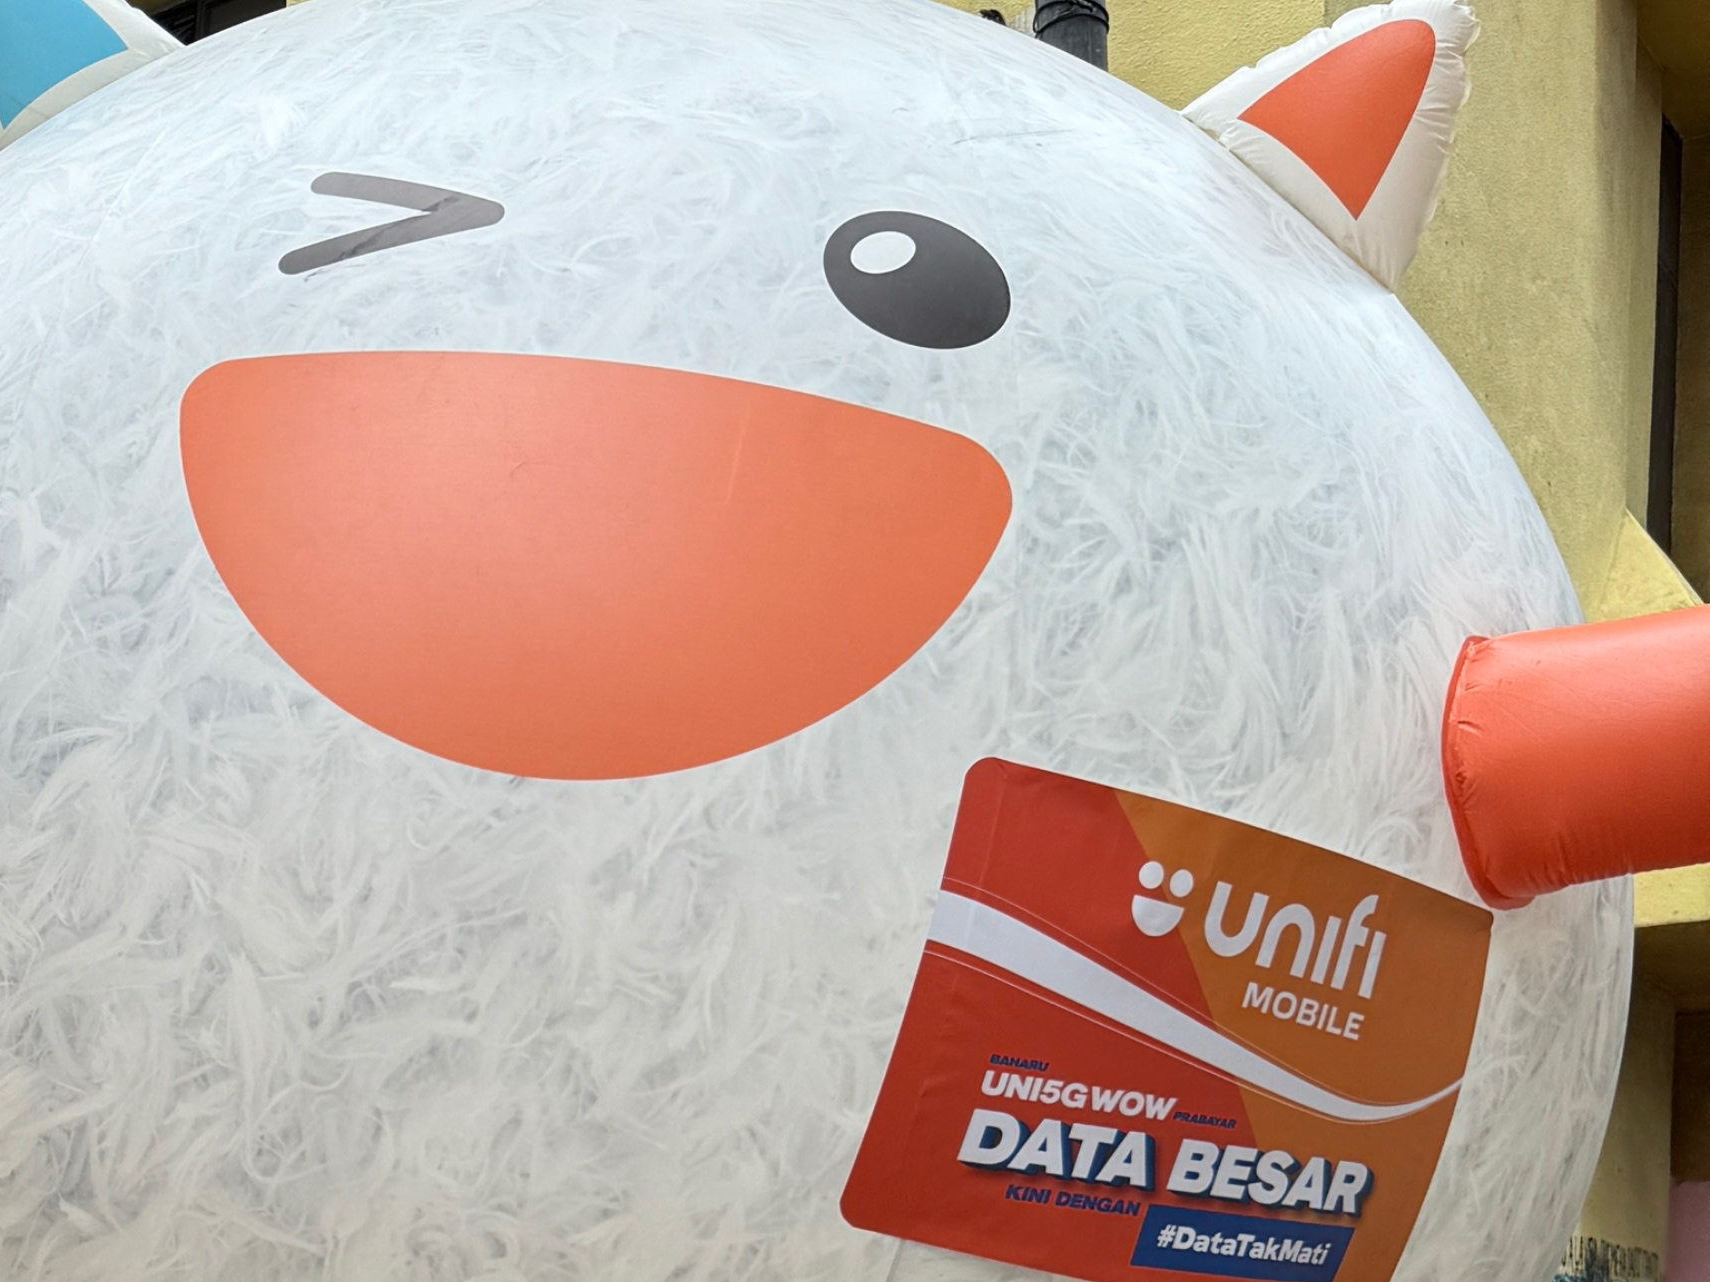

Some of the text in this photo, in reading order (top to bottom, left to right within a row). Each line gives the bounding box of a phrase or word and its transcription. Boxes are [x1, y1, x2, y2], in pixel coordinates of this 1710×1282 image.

[1205, 881, 1387, 1000] unifi
[1242, 983, 1364, 1040] MOBILE
[989, 1053, 1049, 1073] BAHARU
[1174, 1111, 1237, 1129] PRABAYAR
[957, 1108, 1370, 1214] DATA BESAR
[1005, 1185, 1141, 1217] KINI DENGAN
[1158, 1225, 1330, 1265] #DataTakMati
